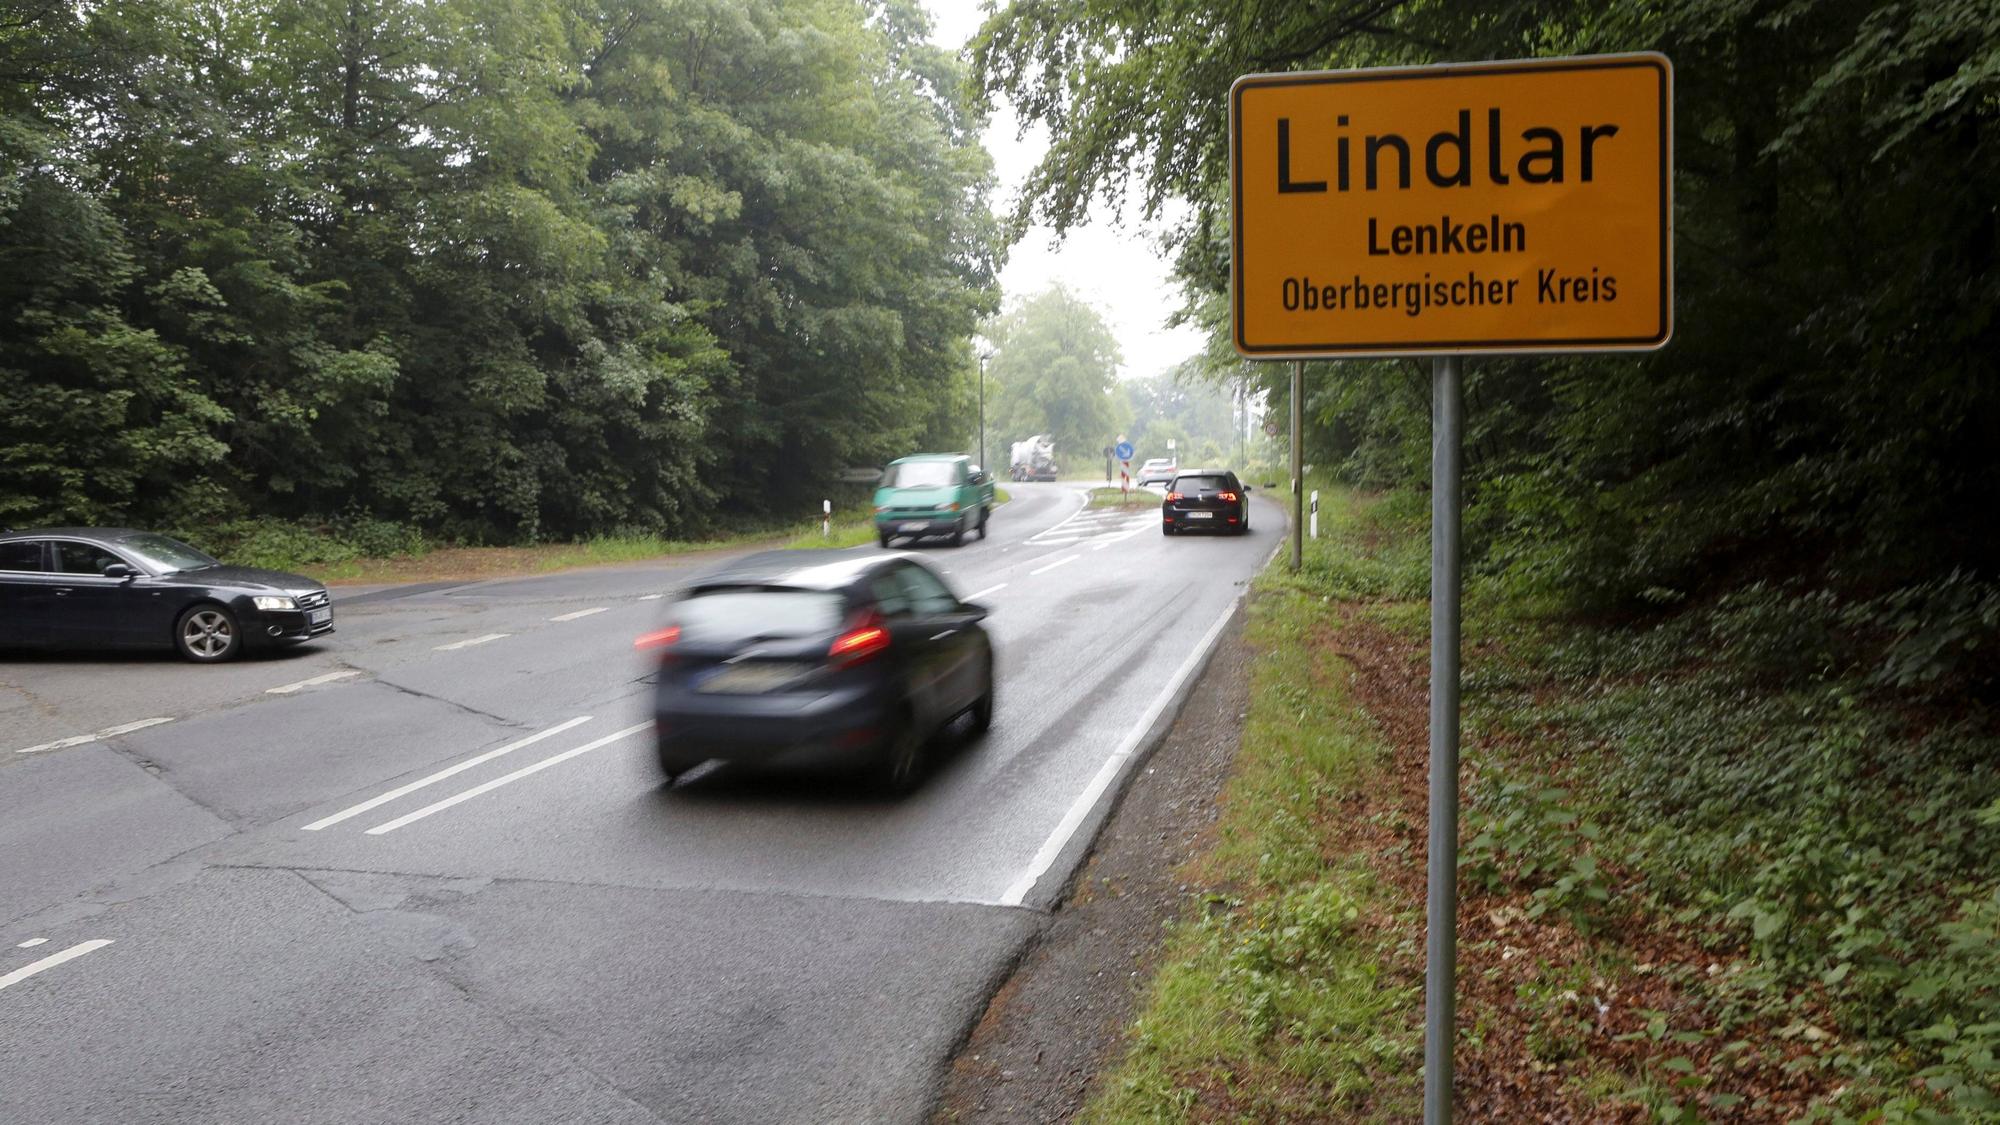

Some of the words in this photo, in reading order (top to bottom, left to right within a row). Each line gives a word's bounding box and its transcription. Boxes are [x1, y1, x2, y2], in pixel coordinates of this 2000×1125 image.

[1277, 107, 1620, 195] Lindlar
[1368, 214, 1526, 257] Lenkeln
[1282, 271, 1519, 318] Oberbergischer
[1537, 267, 1617, 304] Kreis
